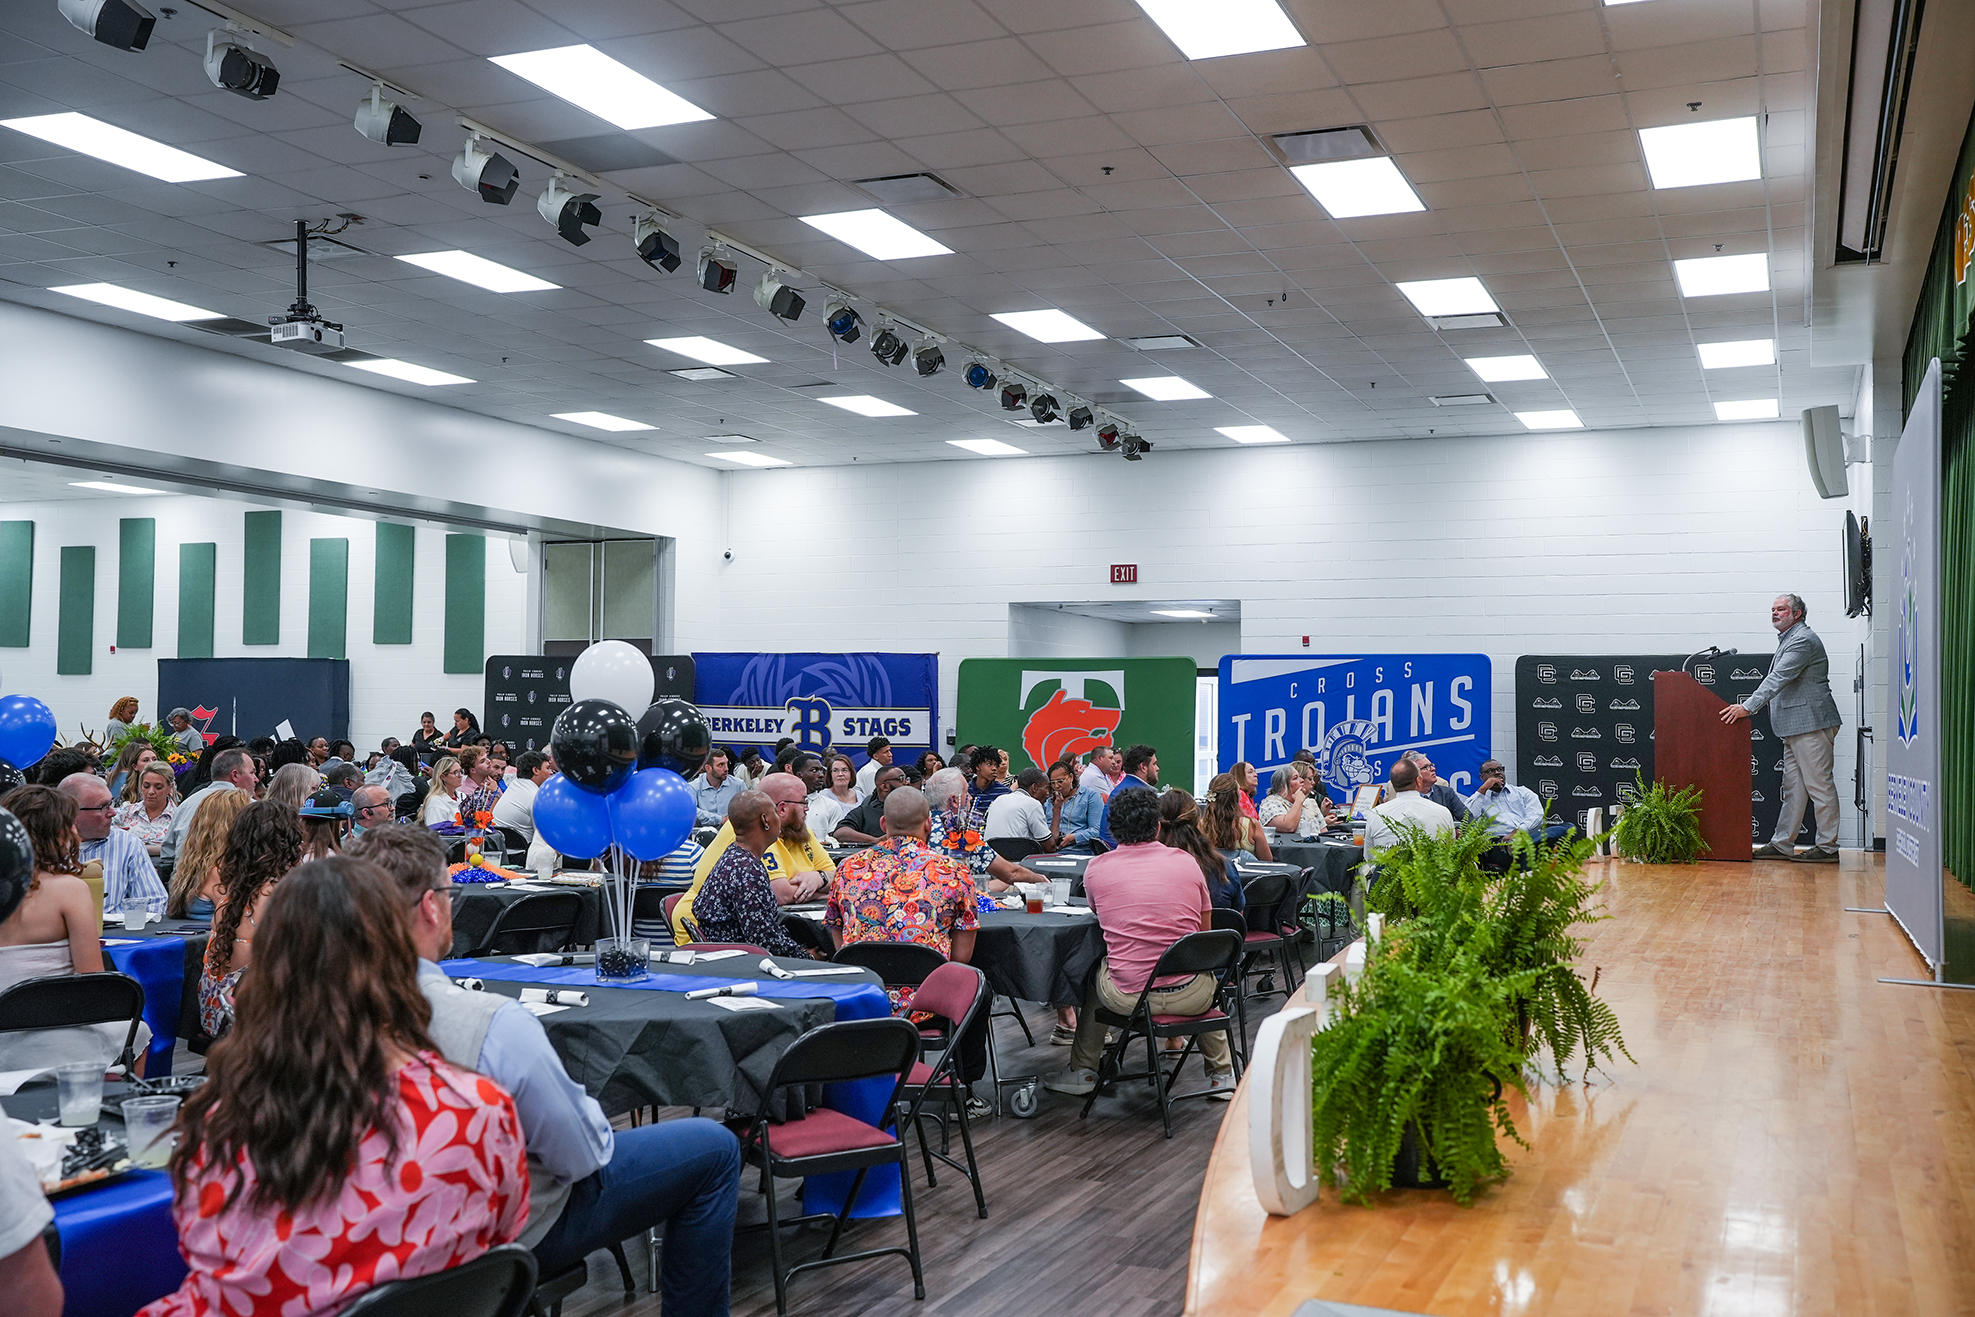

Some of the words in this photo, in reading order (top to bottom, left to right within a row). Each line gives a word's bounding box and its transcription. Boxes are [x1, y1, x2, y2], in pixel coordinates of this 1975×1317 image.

[1114, 566, 1135, 581] EXIT
[1290, 661, 1413, 699] CROSS
[785, 694, 832, 754] B
[842, 717, 912, 737] STAGS
[762, 852, 779, 872] 3
